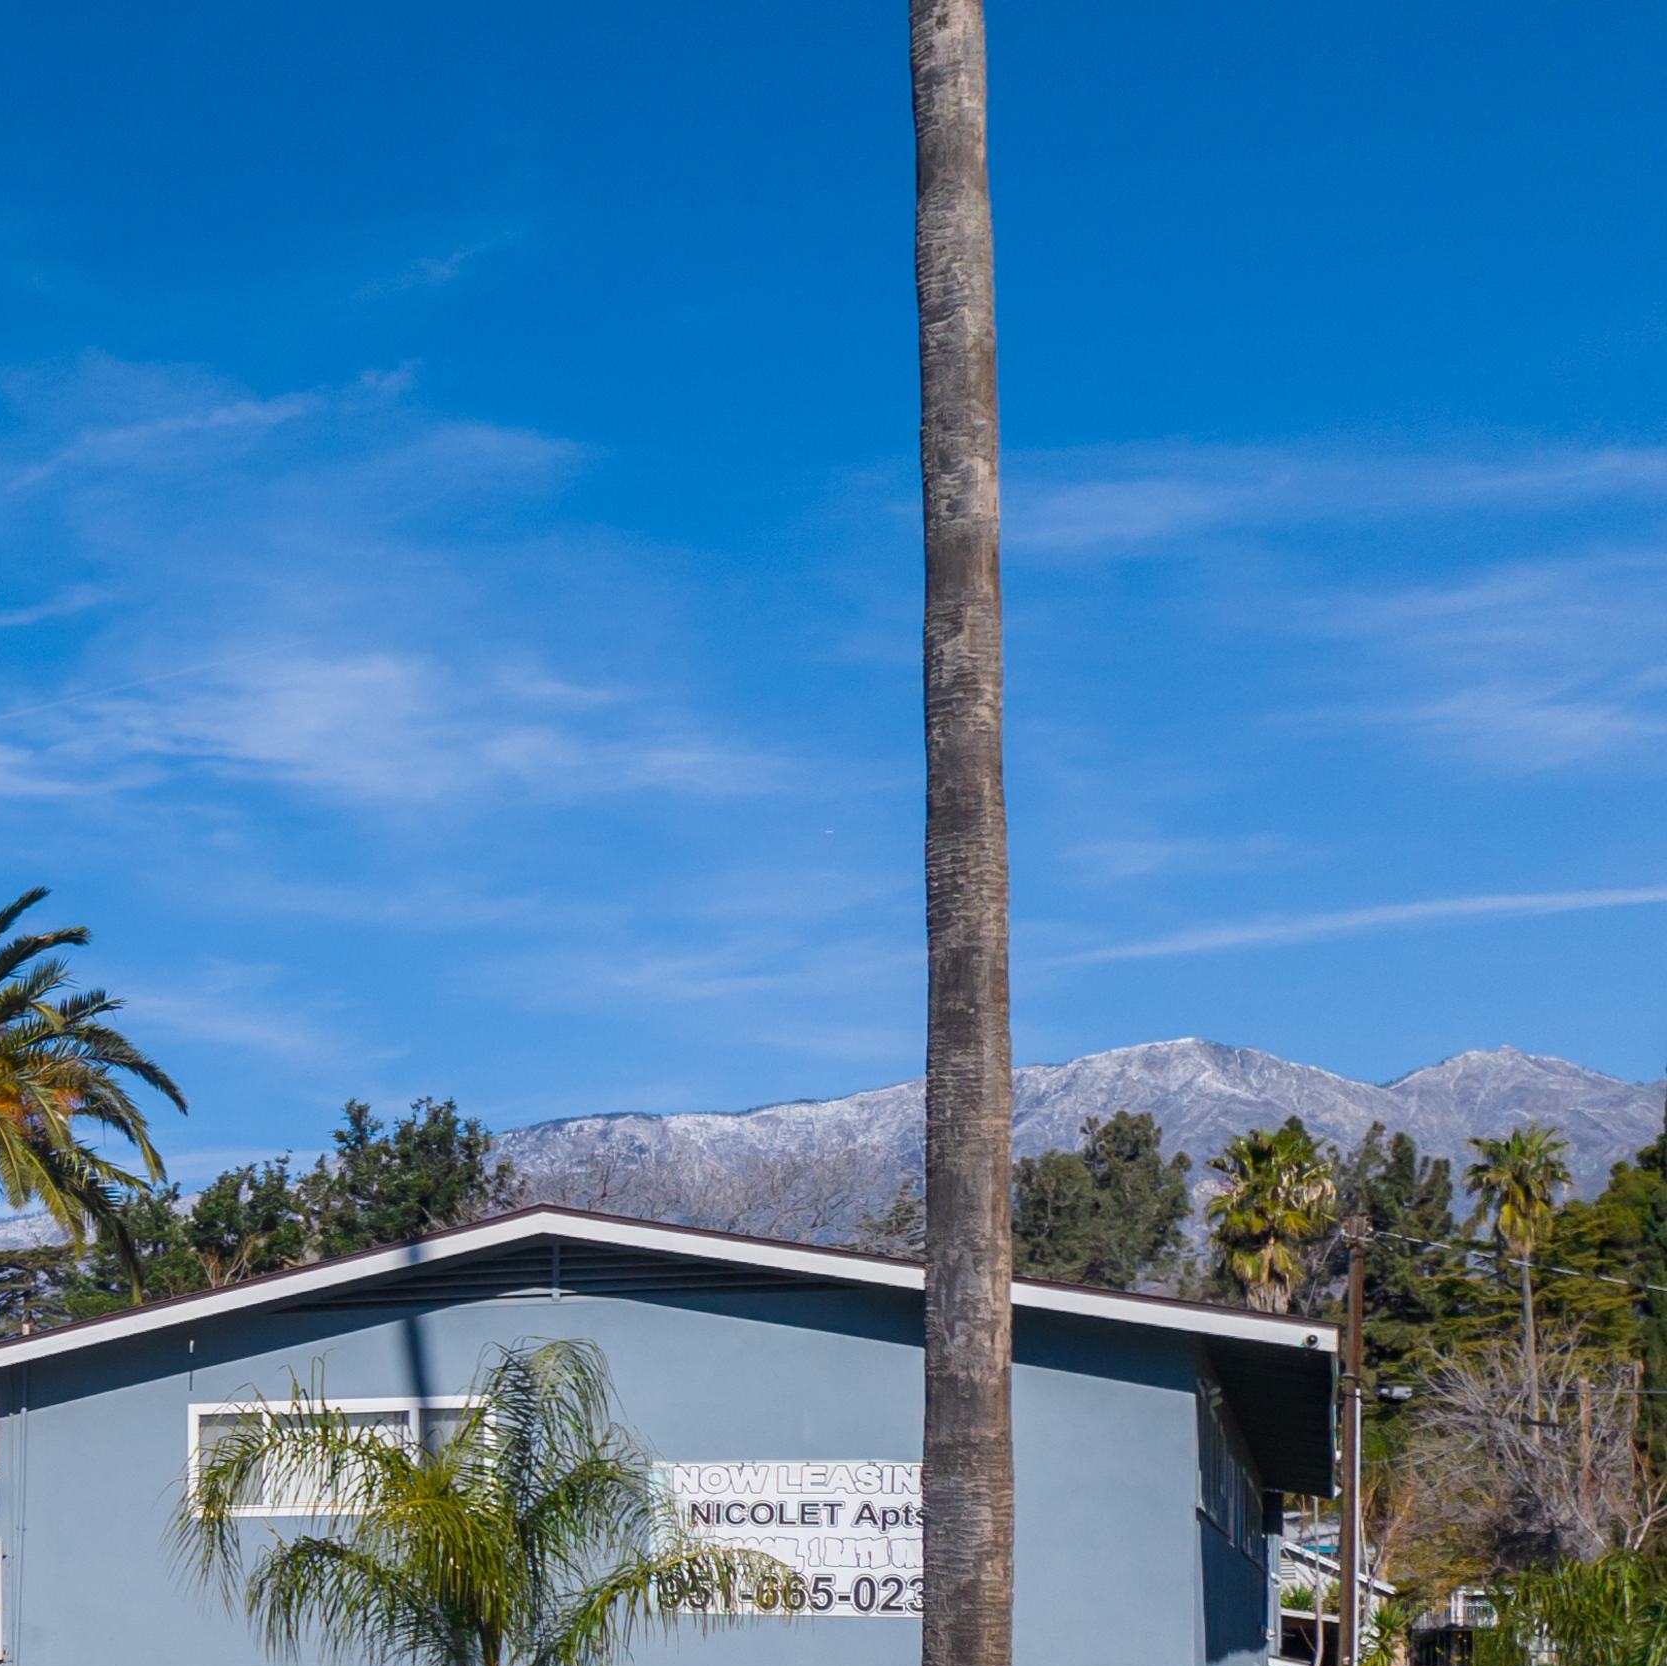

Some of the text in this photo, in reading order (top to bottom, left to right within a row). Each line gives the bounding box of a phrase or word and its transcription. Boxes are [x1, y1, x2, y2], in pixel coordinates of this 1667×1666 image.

[674, 1465, 923, 1494] NOW LEASIN
[690, 1501, 844, 1527] NICOLET
